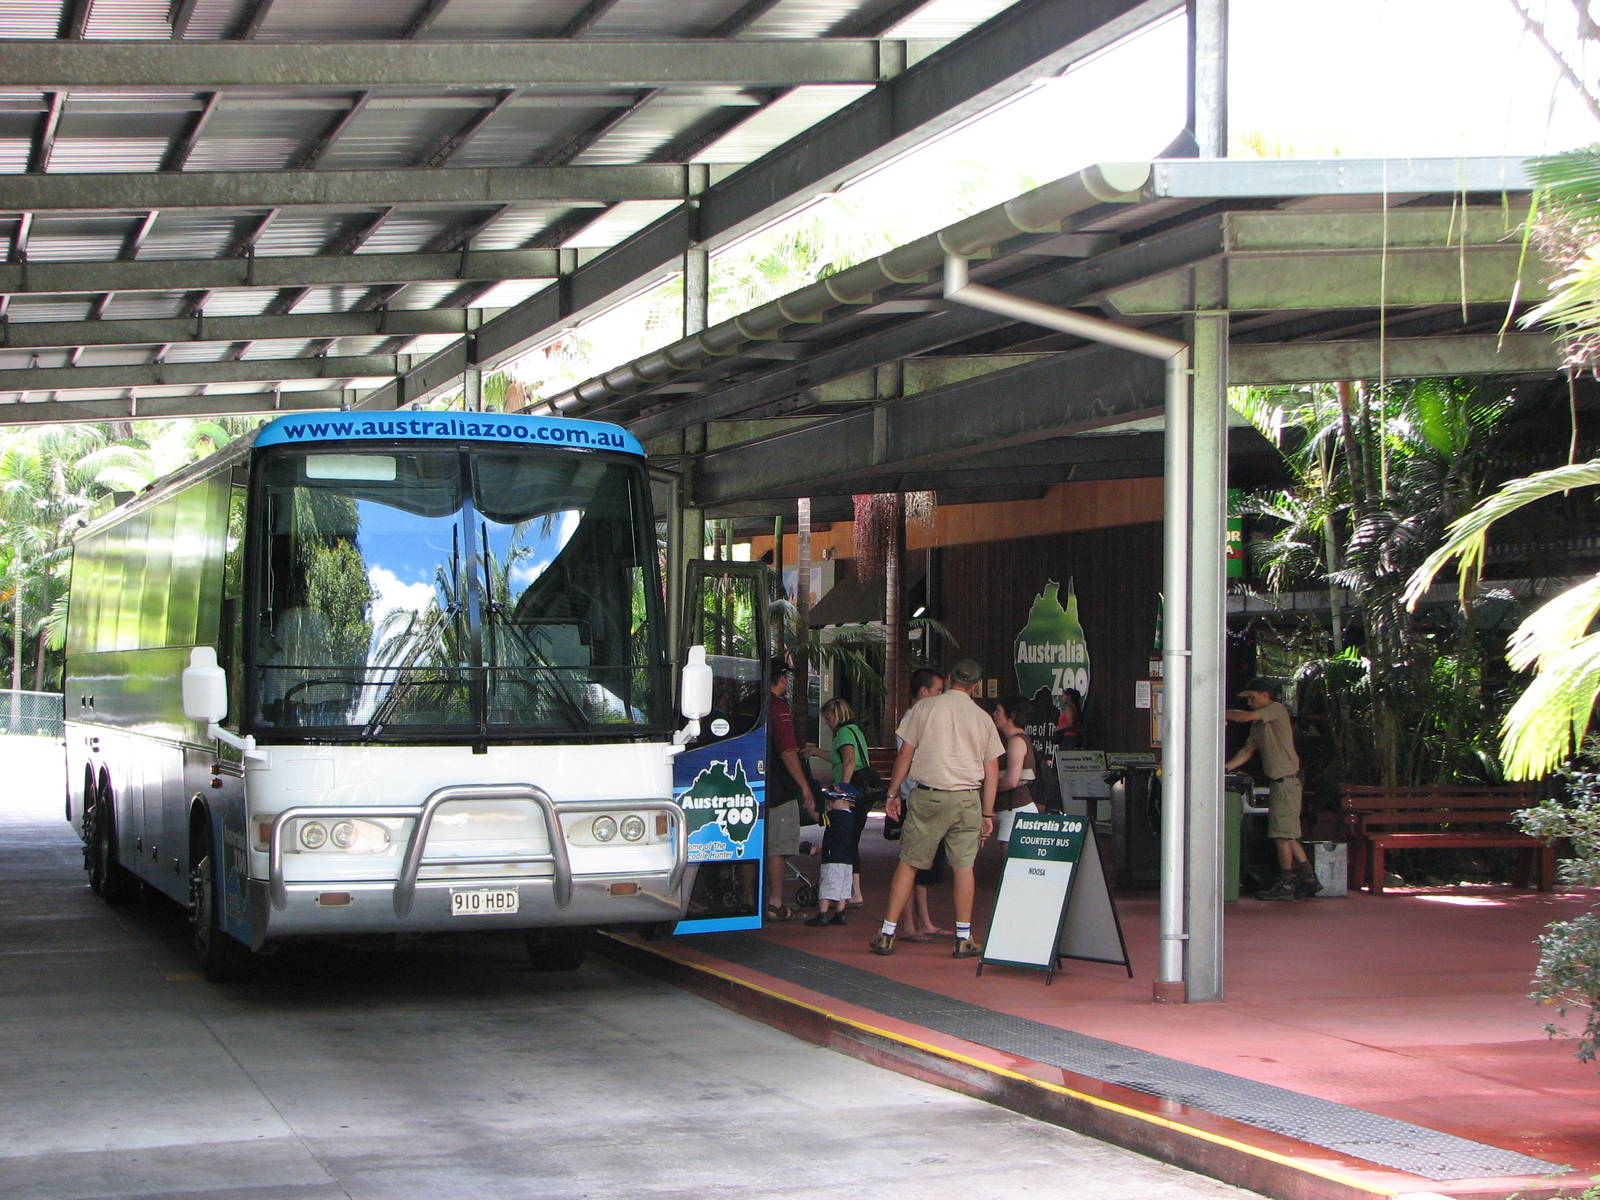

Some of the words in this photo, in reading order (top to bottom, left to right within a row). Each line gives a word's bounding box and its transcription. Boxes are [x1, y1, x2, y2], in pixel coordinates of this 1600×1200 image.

[283, 419, 625, 448] www.australiazoo.com.au
[1017, 640, 1085, 663] Australia
[1052, 667, 1088, 696] ZOO
[1025, 724, 1037, 736] me
[1038, 722, 1046, 736] of
[1047, 722, 1057, 736] Th
[682, 794, 753, 809] Australia
[714, 808, 753, 825] ZOO
[1015, 819, 1060, 831] Australia
[1062, 821, 1082, 833] ZOO
[688, 843, 704, 851] ome
[704, 842, 712, 851] of
[712, 841, 726, 850] The
[1020, 836, 1056, 846] COURTESY
[1056, 838, 1070, 847] BUS
[688, 851, 709, 860] codile
[710, 850, 733, 860] Hunter
[1037, 848, 1047, 857] TO
[1028, 867, 1046, 876] NOOSA
